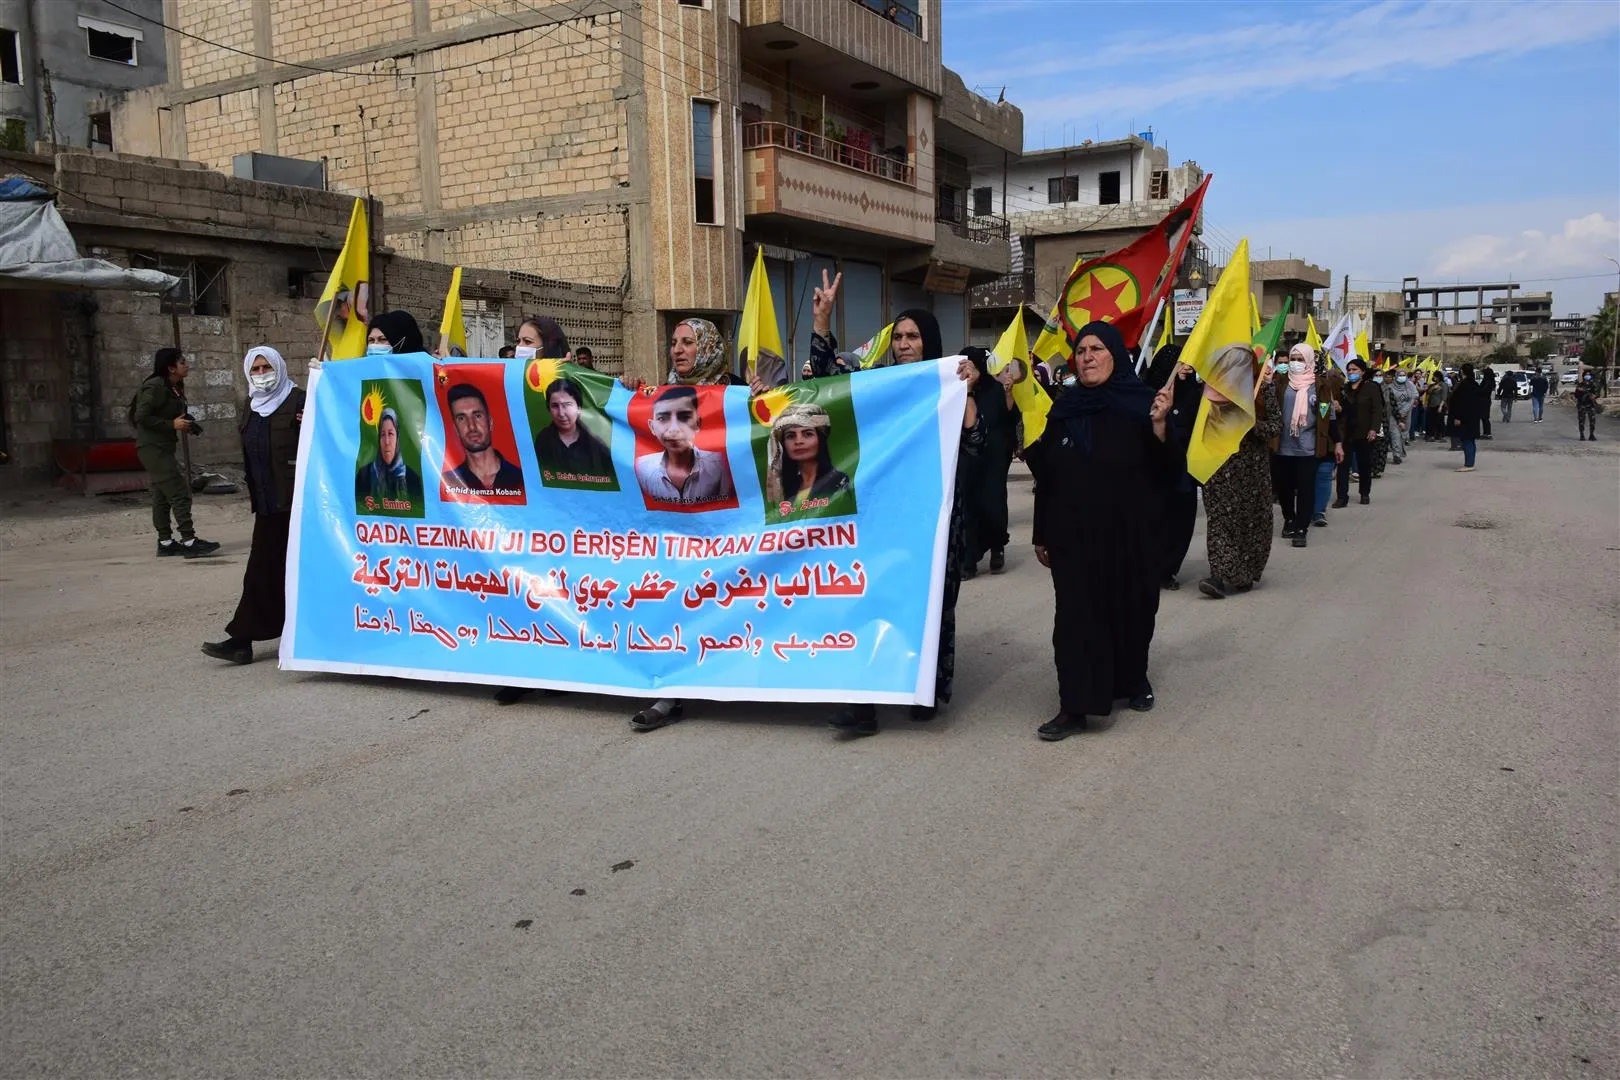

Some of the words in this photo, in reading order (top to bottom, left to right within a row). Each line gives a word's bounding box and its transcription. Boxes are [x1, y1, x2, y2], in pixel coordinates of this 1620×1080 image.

[382, 498, 411, 510] Emine
[801, 497, 831, 511] Zehra
[356, 523, 412, 545] QADA
[416, 526, 494, 550] EZMANI
[503, 531, 523, 553] JI
[531, 532, 566, 554] BO
[573, 529, 657, 561] ÊRÎŞÊN
[664, 534, 755, 558] TIRKAN
[758, 523, 855, 551] BIGRIN
[353, 554, 430, 594] التركية
[434, 560, 522, 601] الهجمات
[526, 568, 570, 610] لمنع
[573, 575, 619, 612] جوي
[622, 572, 678, 608] حظر
[684, 568, 768, 609] بفرض
[774, 561, 866, 606] نطالب
